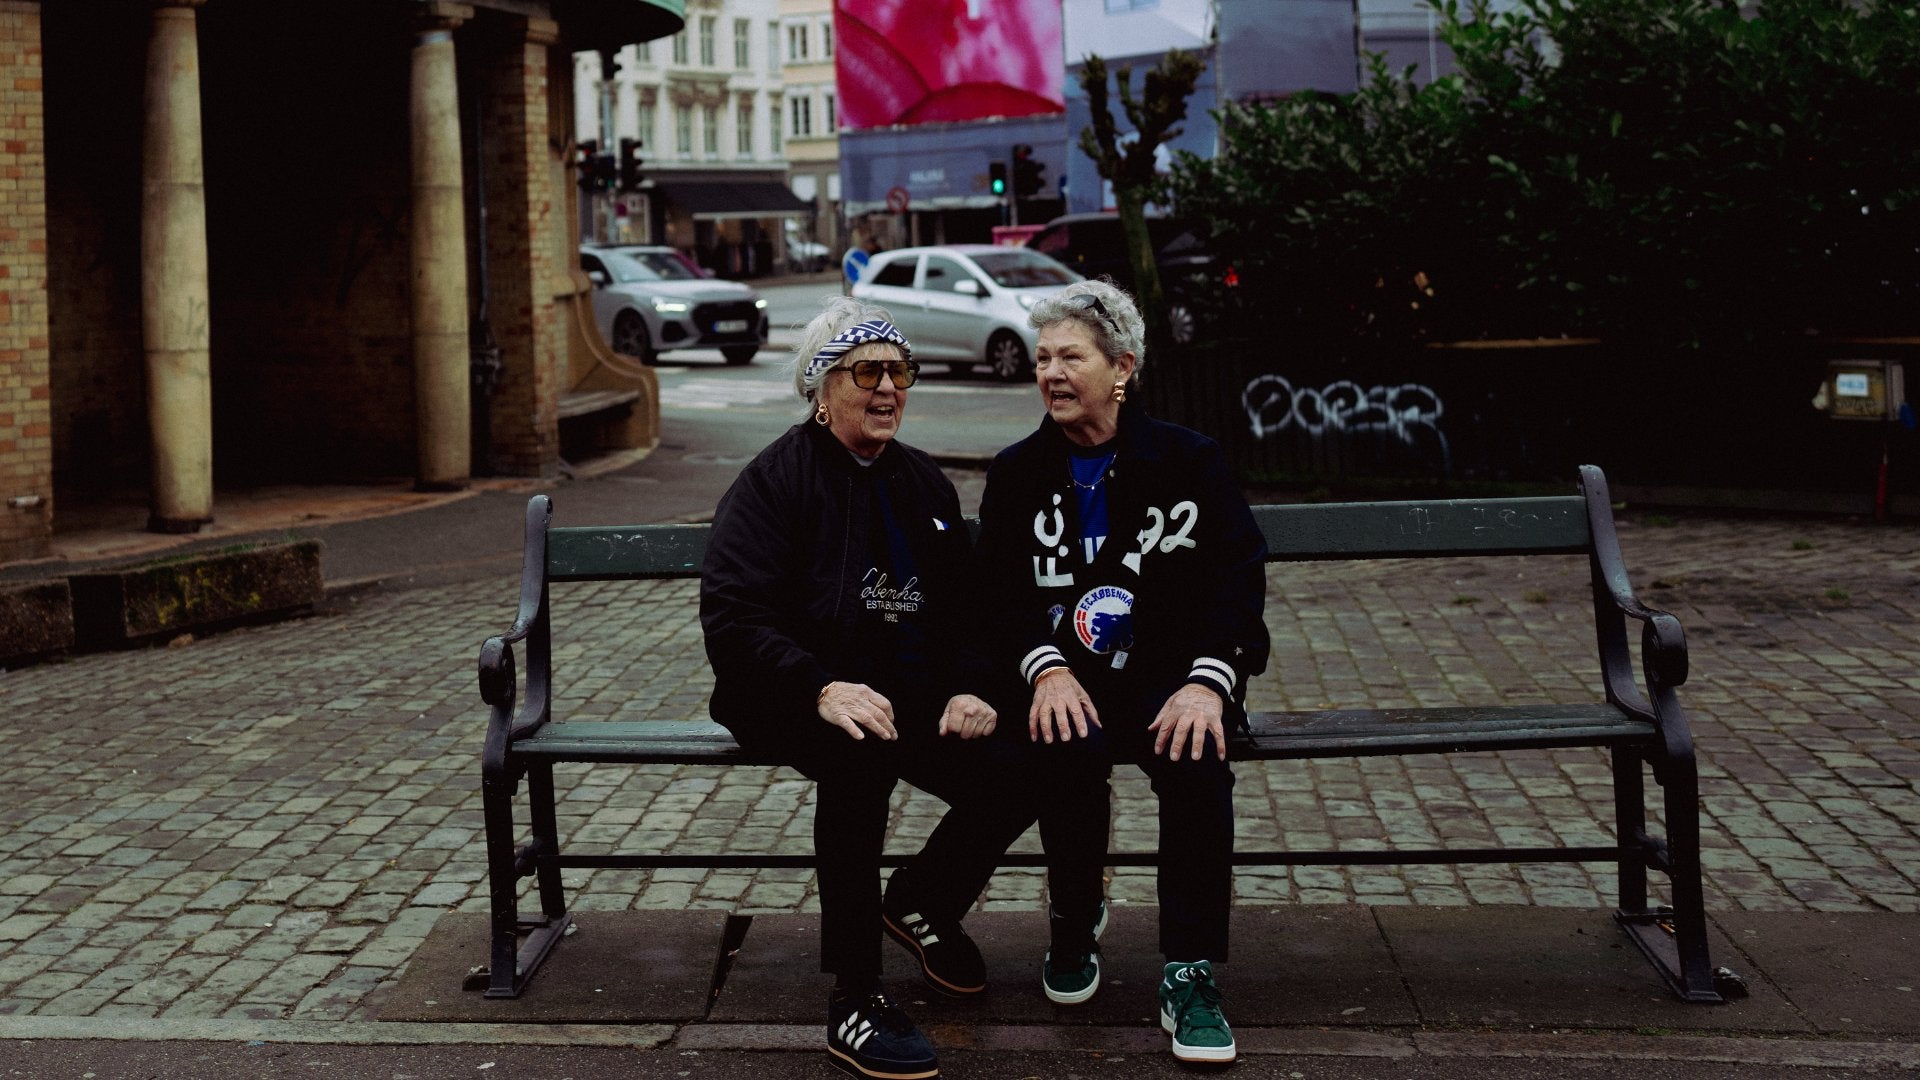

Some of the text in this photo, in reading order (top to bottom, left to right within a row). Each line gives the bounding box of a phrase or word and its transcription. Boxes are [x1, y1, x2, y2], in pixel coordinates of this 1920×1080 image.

[1033, 493, 1075, 587] F.C.
[866, 600, 918, 612] ESTABLISHED
[884, 613, 899, 622] 1992
